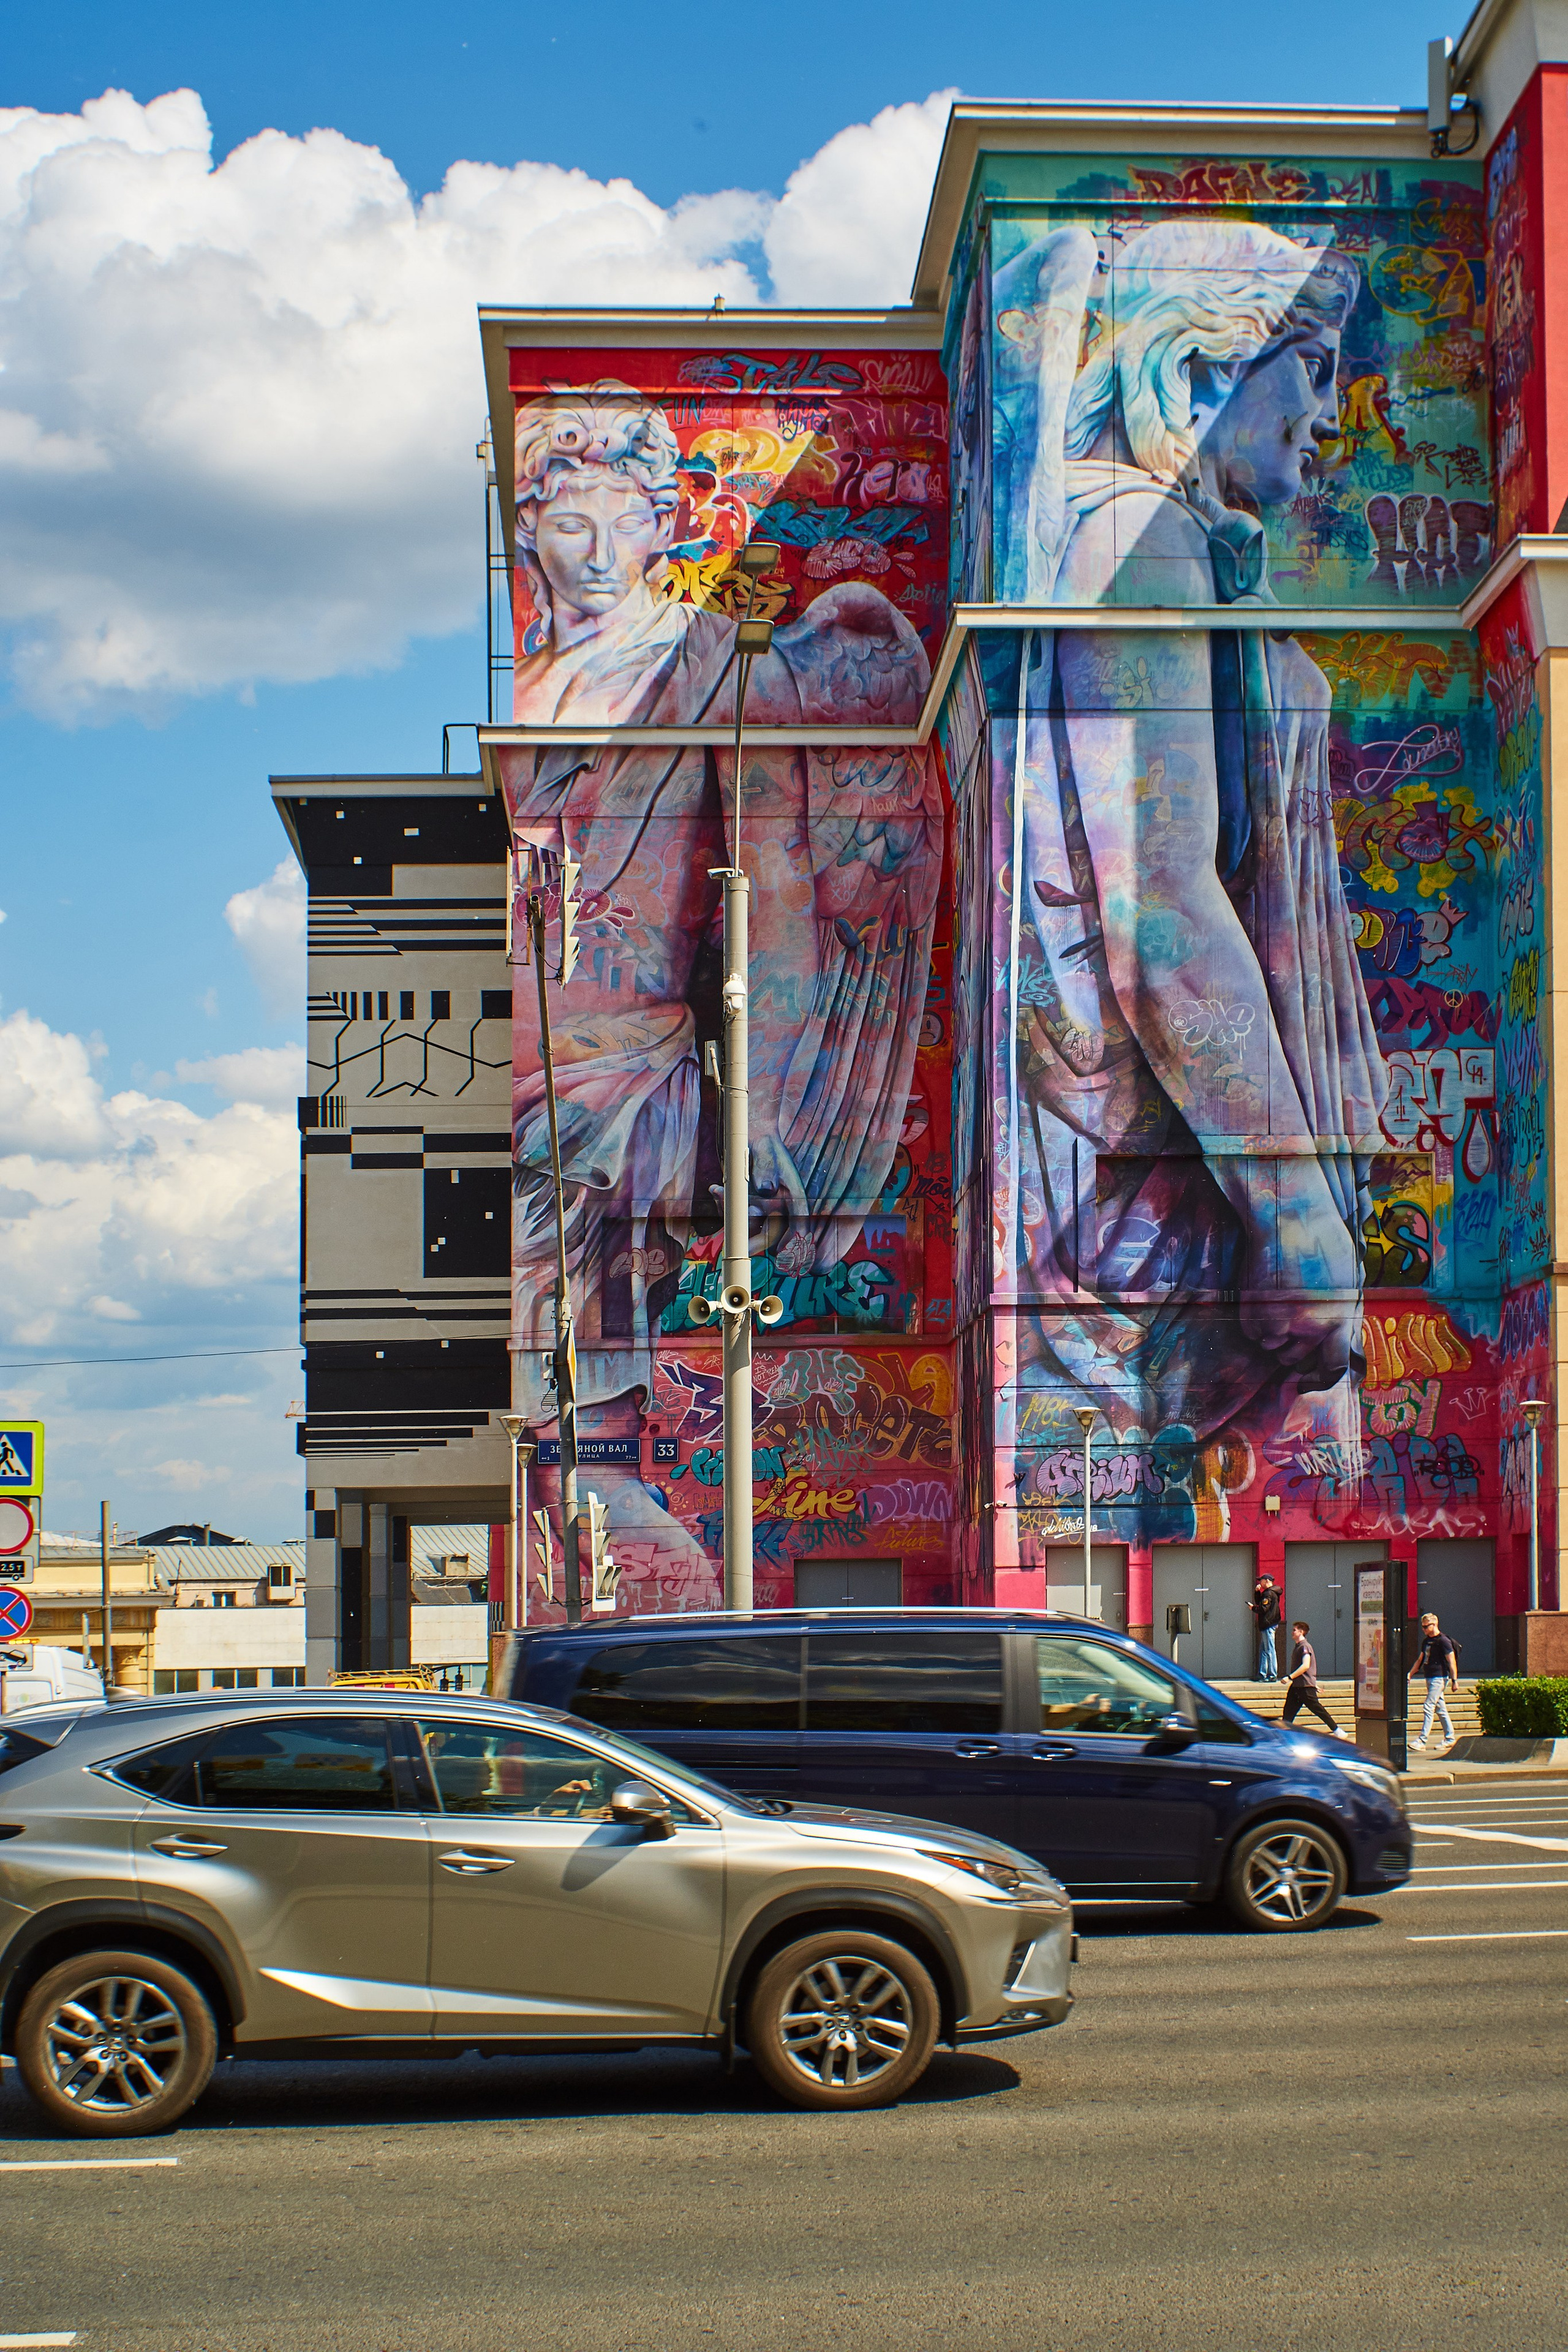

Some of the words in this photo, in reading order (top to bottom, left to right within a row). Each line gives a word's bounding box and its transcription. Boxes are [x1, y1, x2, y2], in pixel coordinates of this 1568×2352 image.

[550, 1443, 605, 1453] ЗЕЯНОЙ
[657, 1444, 675, 1457] 33
[1, 1563, 15, 1572] 2,5
